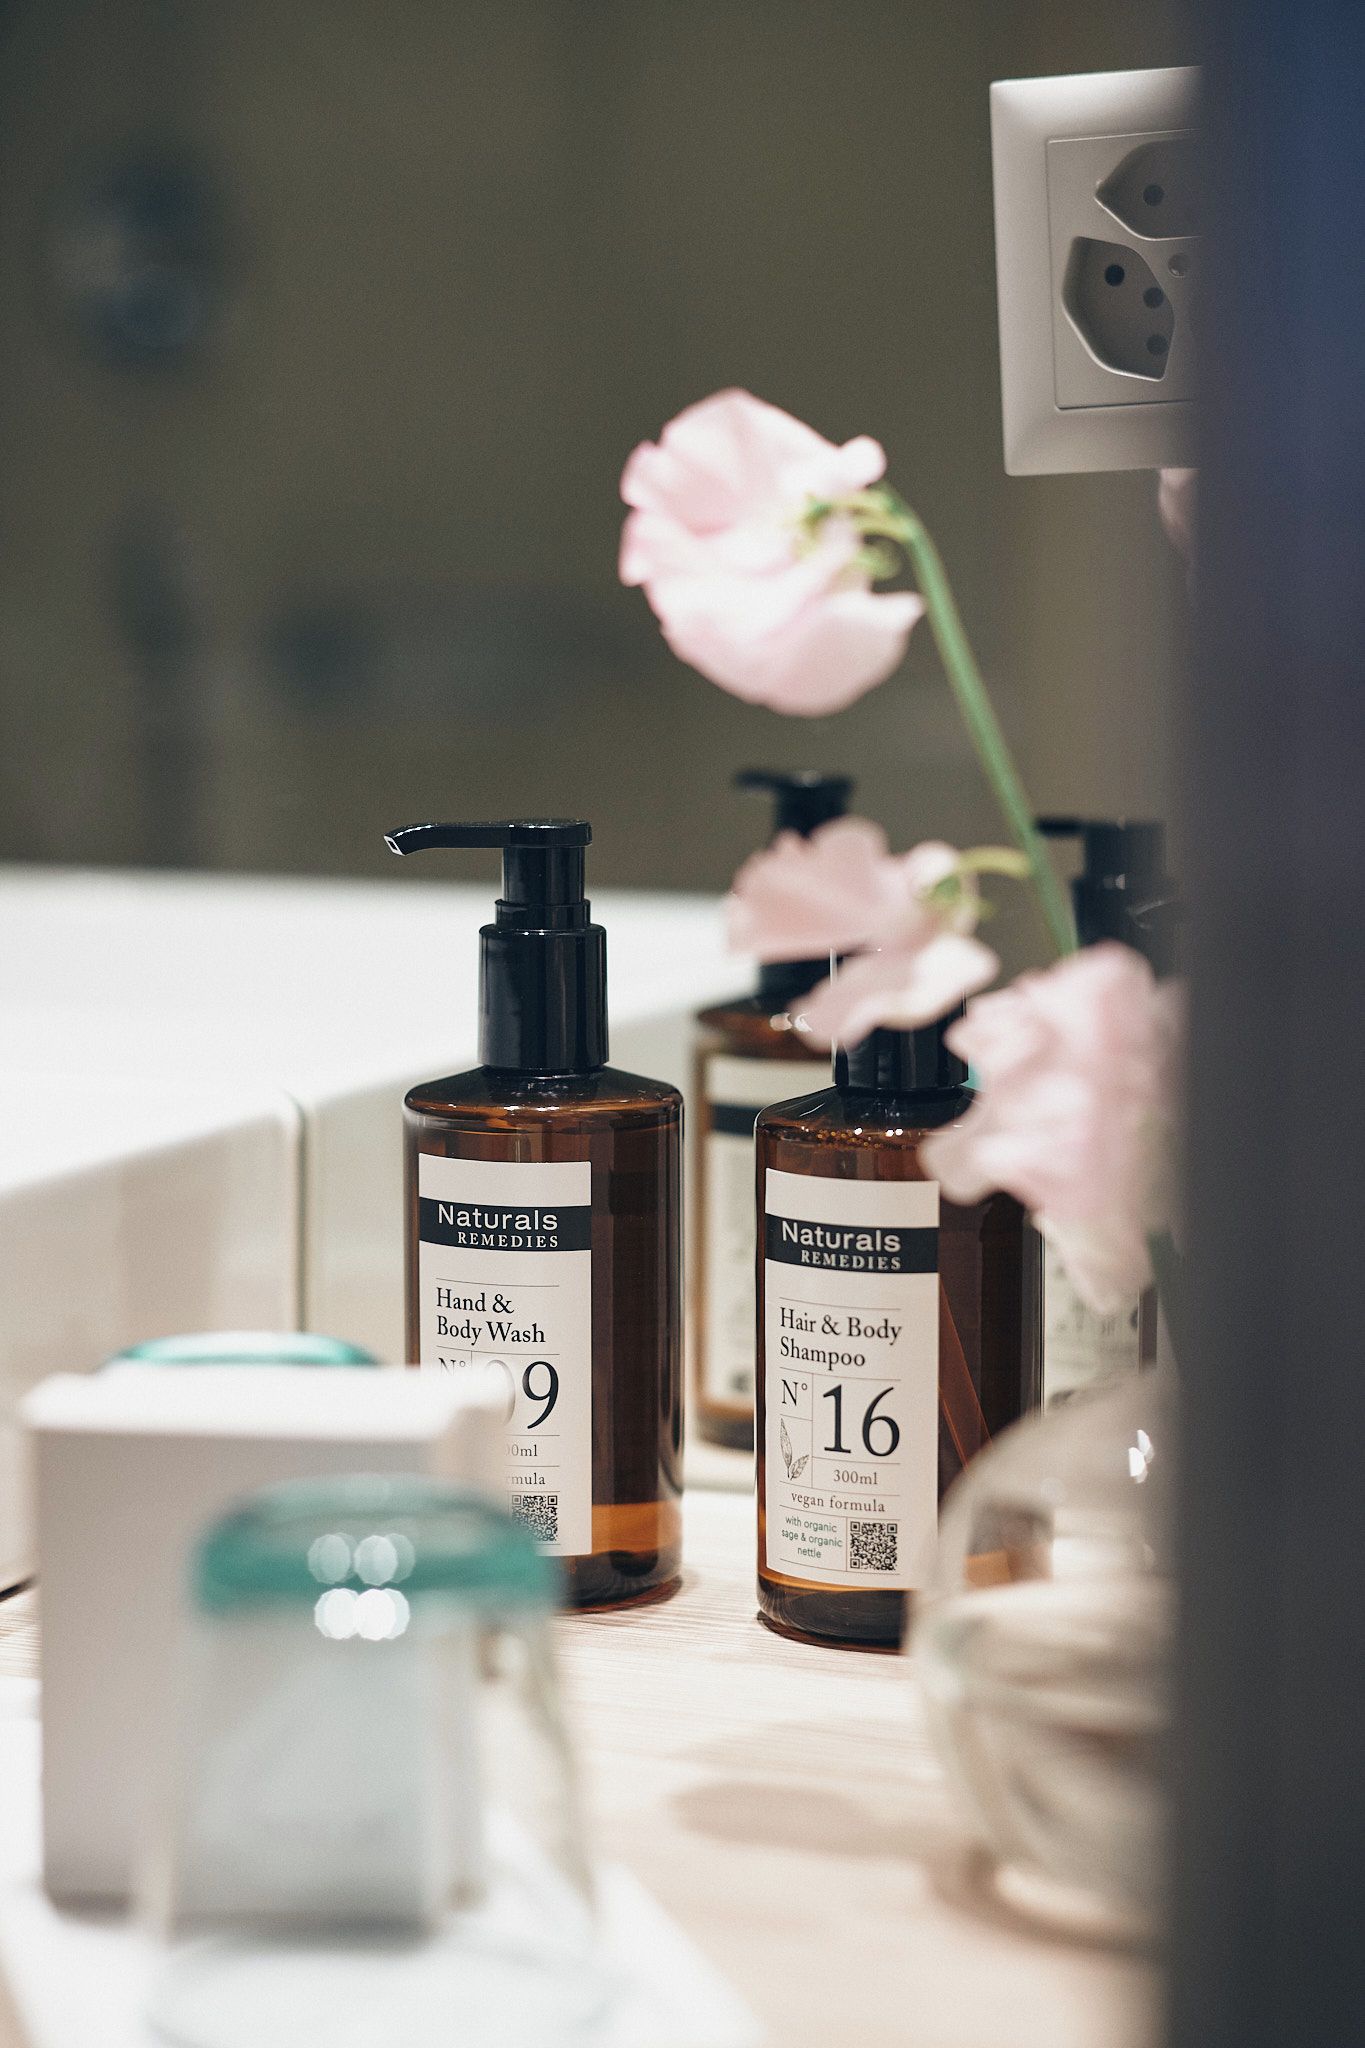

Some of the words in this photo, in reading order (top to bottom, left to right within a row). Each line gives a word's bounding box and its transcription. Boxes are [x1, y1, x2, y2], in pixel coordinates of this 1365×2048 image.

[437, 1203, 558, 1231] Naturals
[457, 1231, 559, 1248] REMEDIES
[781, 1220, 901, 1252] Naturals
[801, 1249, 901, 1270] REMEDIES
[436, 1287, 487, 1312] Hand
[492, 1293, 515, 1314] &
[437, 1315, 482, 1346] Body
[486, 1320, 546, 1343] Wash
[780, 1307, 816, 1332] Hair
[821, 1314, 841, 1336] &
[847, 1316, 902, 1346] Body
[780, 1336, 865, 1371] Shampoo
[822, 1384, 900, 1457] 16
[833, 1469, 879, 1485] 300ml
[791, 1492, 824, 1508] vegan
[829, 1495, 885, 1512] formula
[785, 1516, 802, 1527] with
[803, 1520, 838, 1534] organic
[781, 1529, 799, 1541] sage
[800, 1532, 807, 1542] &
[808, 1535, 843, 1548] organic
[797, 1547, 822, 1559] nettle
